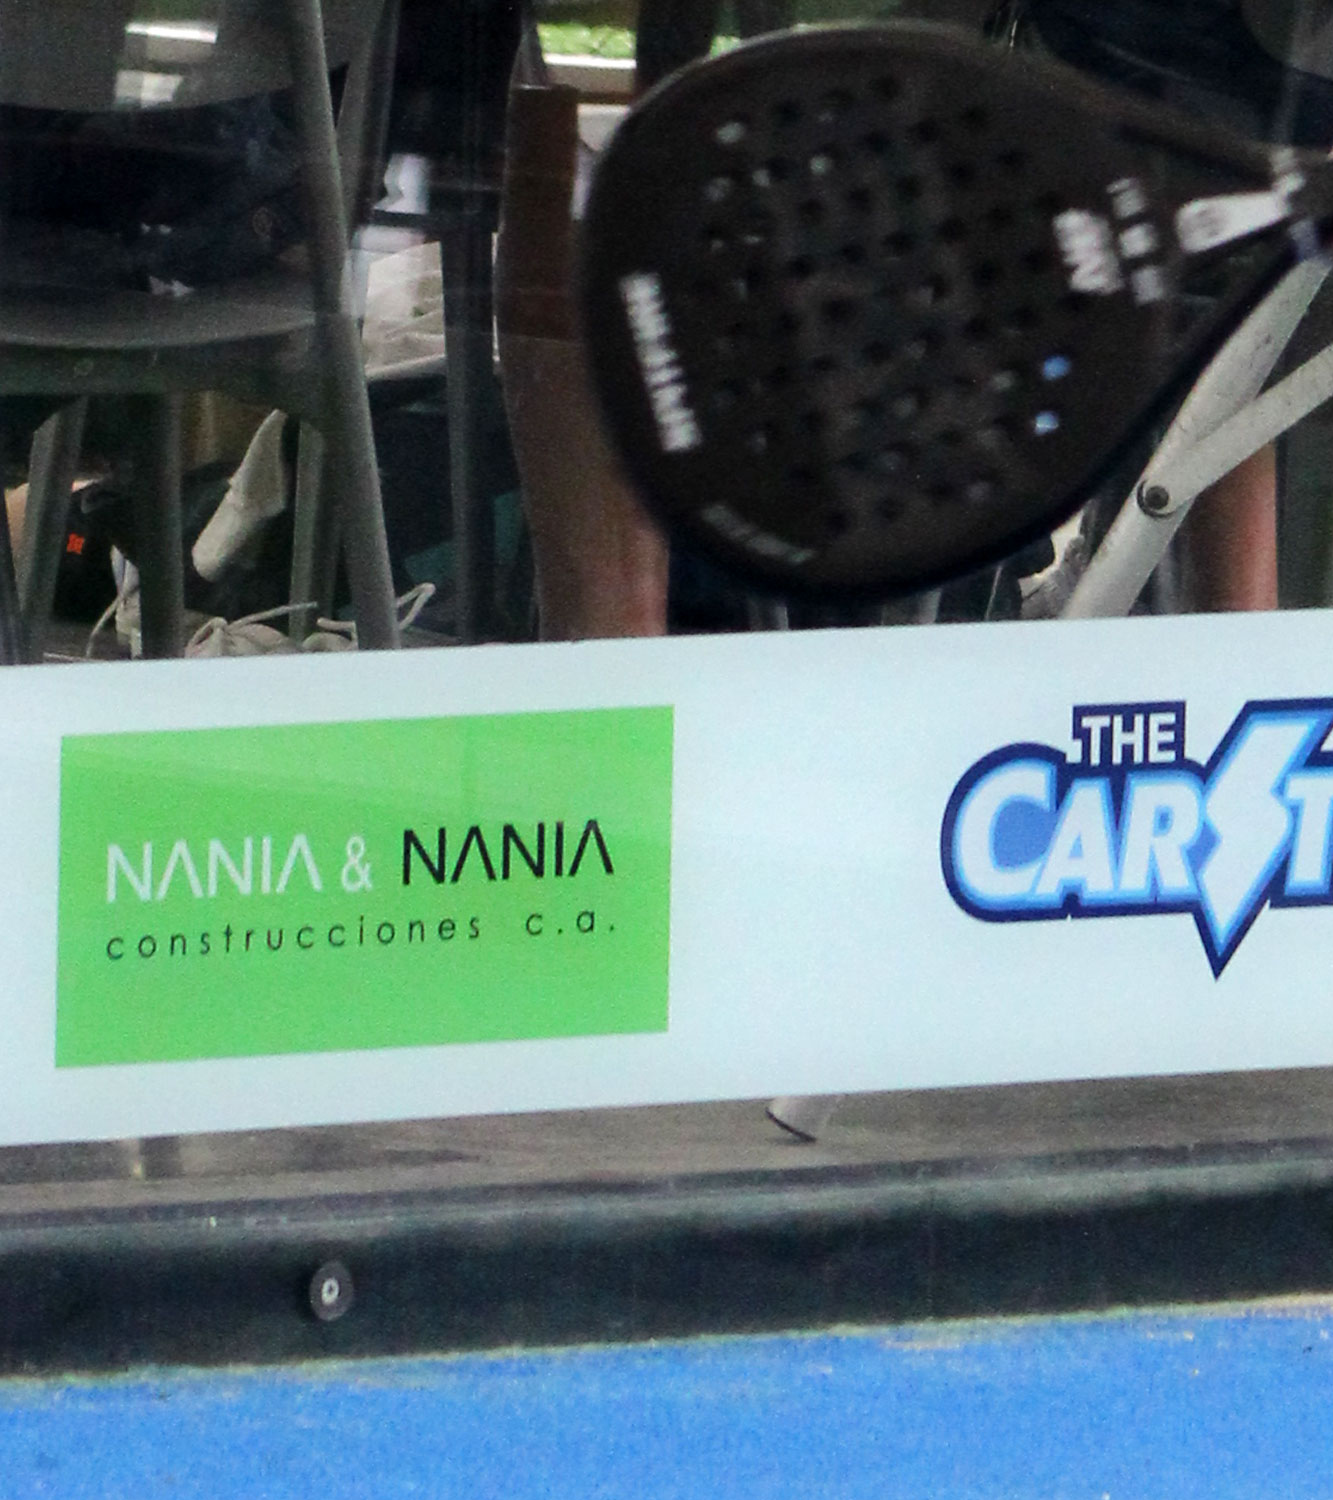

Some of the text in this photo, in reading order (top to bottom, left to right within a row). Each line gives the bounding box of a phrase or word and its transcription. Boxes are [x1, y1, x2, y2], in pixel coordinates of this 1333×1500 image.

[1080, 711, 1178, 765] THE
[105, 817, 616, 905] NANIA & NANIA
[105, 905, 618, 962] construcciones c.a.
